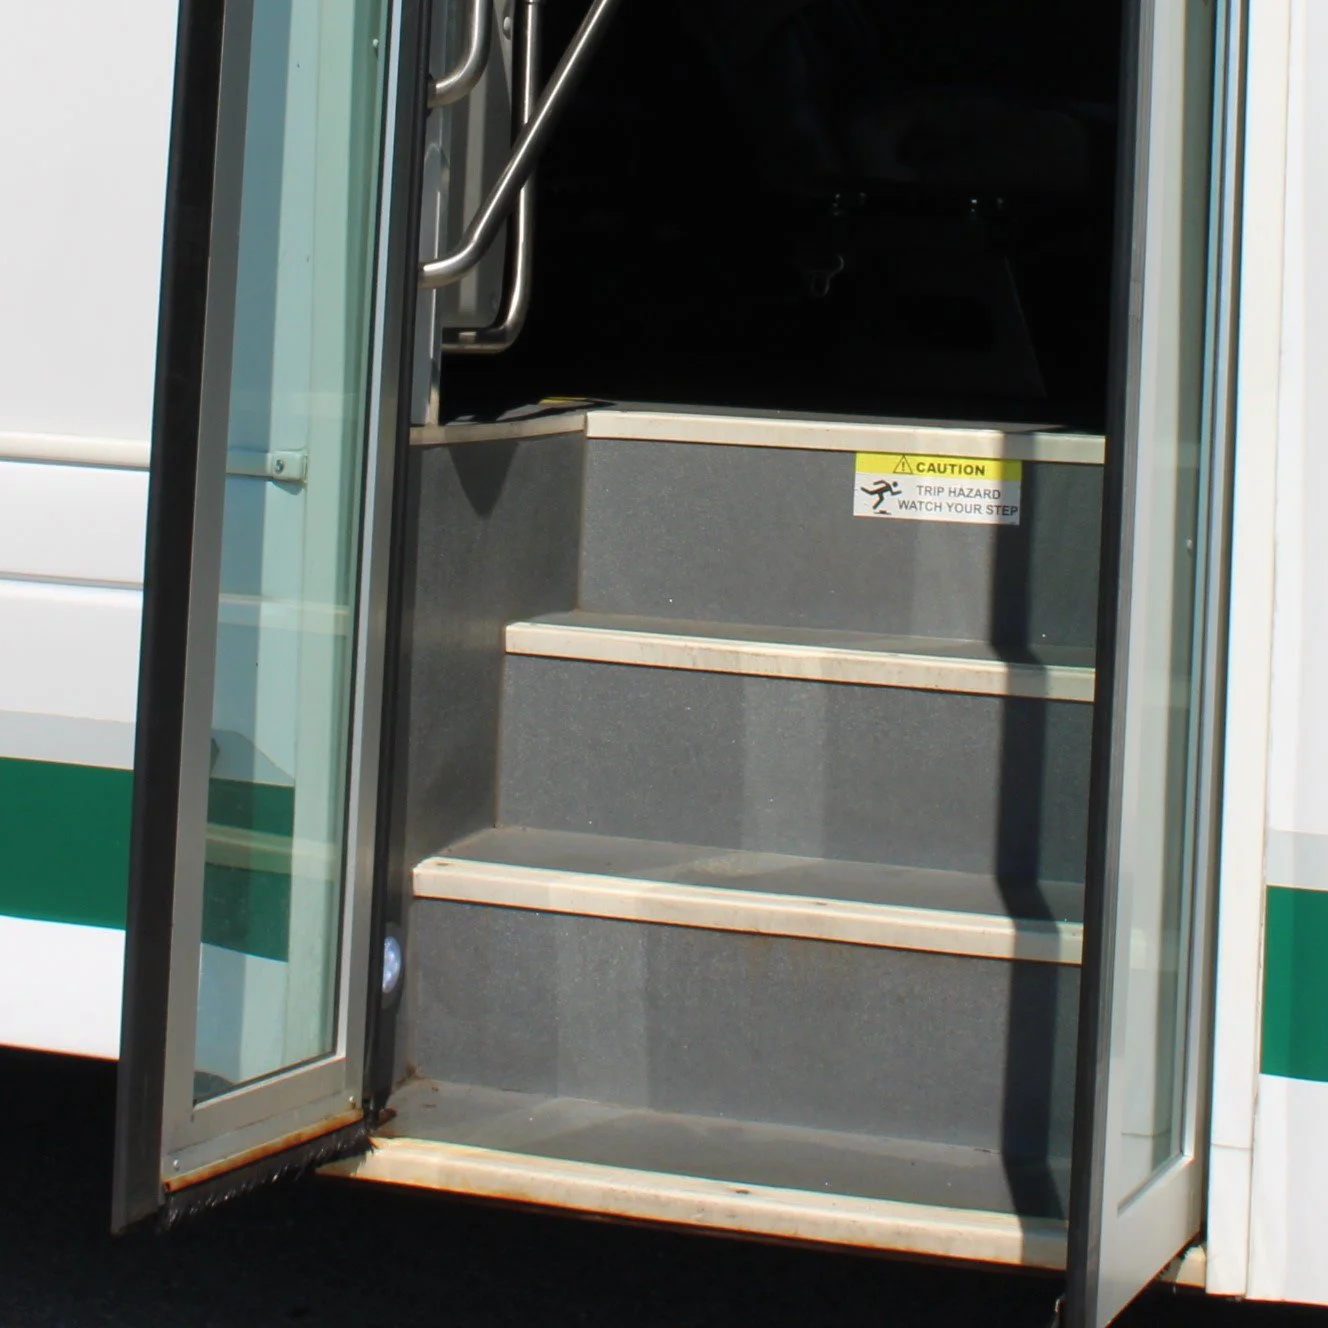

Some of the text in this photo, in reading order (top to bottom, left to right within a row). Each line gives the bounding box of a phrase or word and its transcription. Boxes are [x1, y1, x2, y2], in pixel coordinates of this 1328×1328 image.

[916, 462, 986, 476] CAUTION
[916, 485, 1001, 500] TRIP HAZARD
[898, 499, 1019, 517] WATCH YOUR STEP
